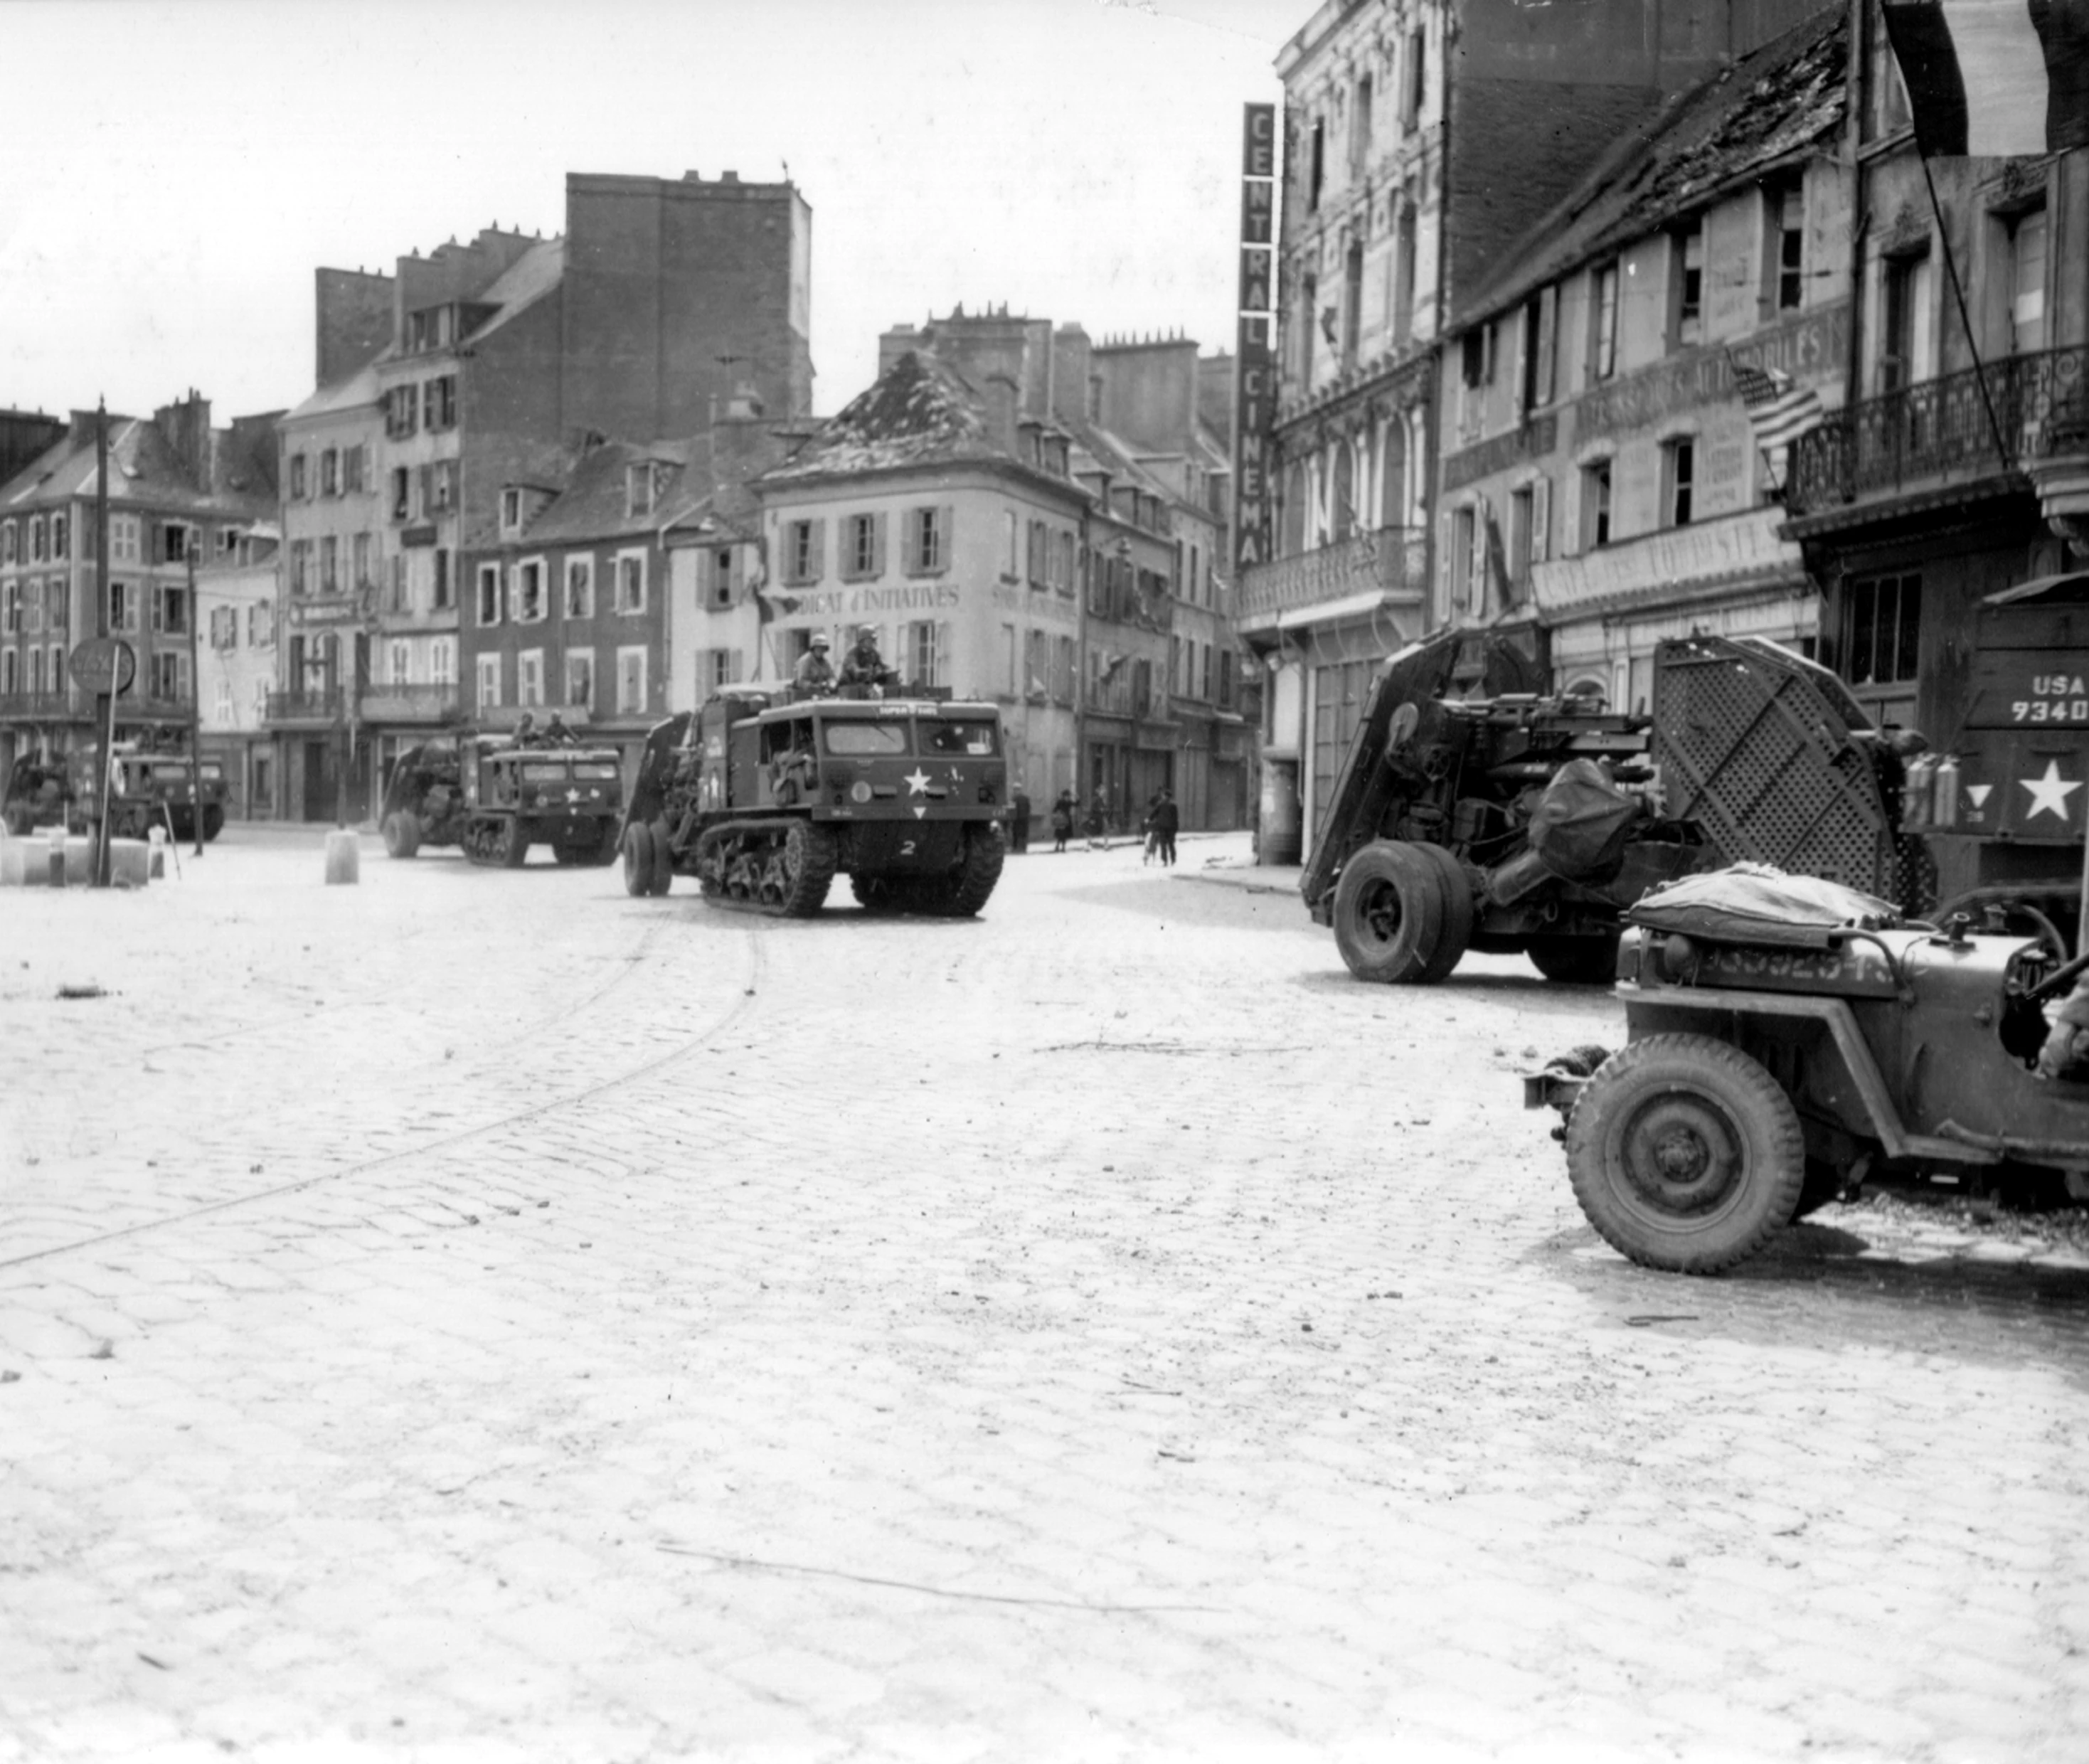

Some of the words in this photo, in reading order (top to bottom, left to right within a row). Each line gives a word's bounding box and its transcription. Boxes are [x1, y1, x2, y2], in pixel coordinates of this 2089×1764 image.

[1247, 112, 1269, 344] CENTRAL
[2032, 675, 2086, 695] USA
[2011, 700, 2089, 722] 9340
[900, 840, 916, 855] 2
